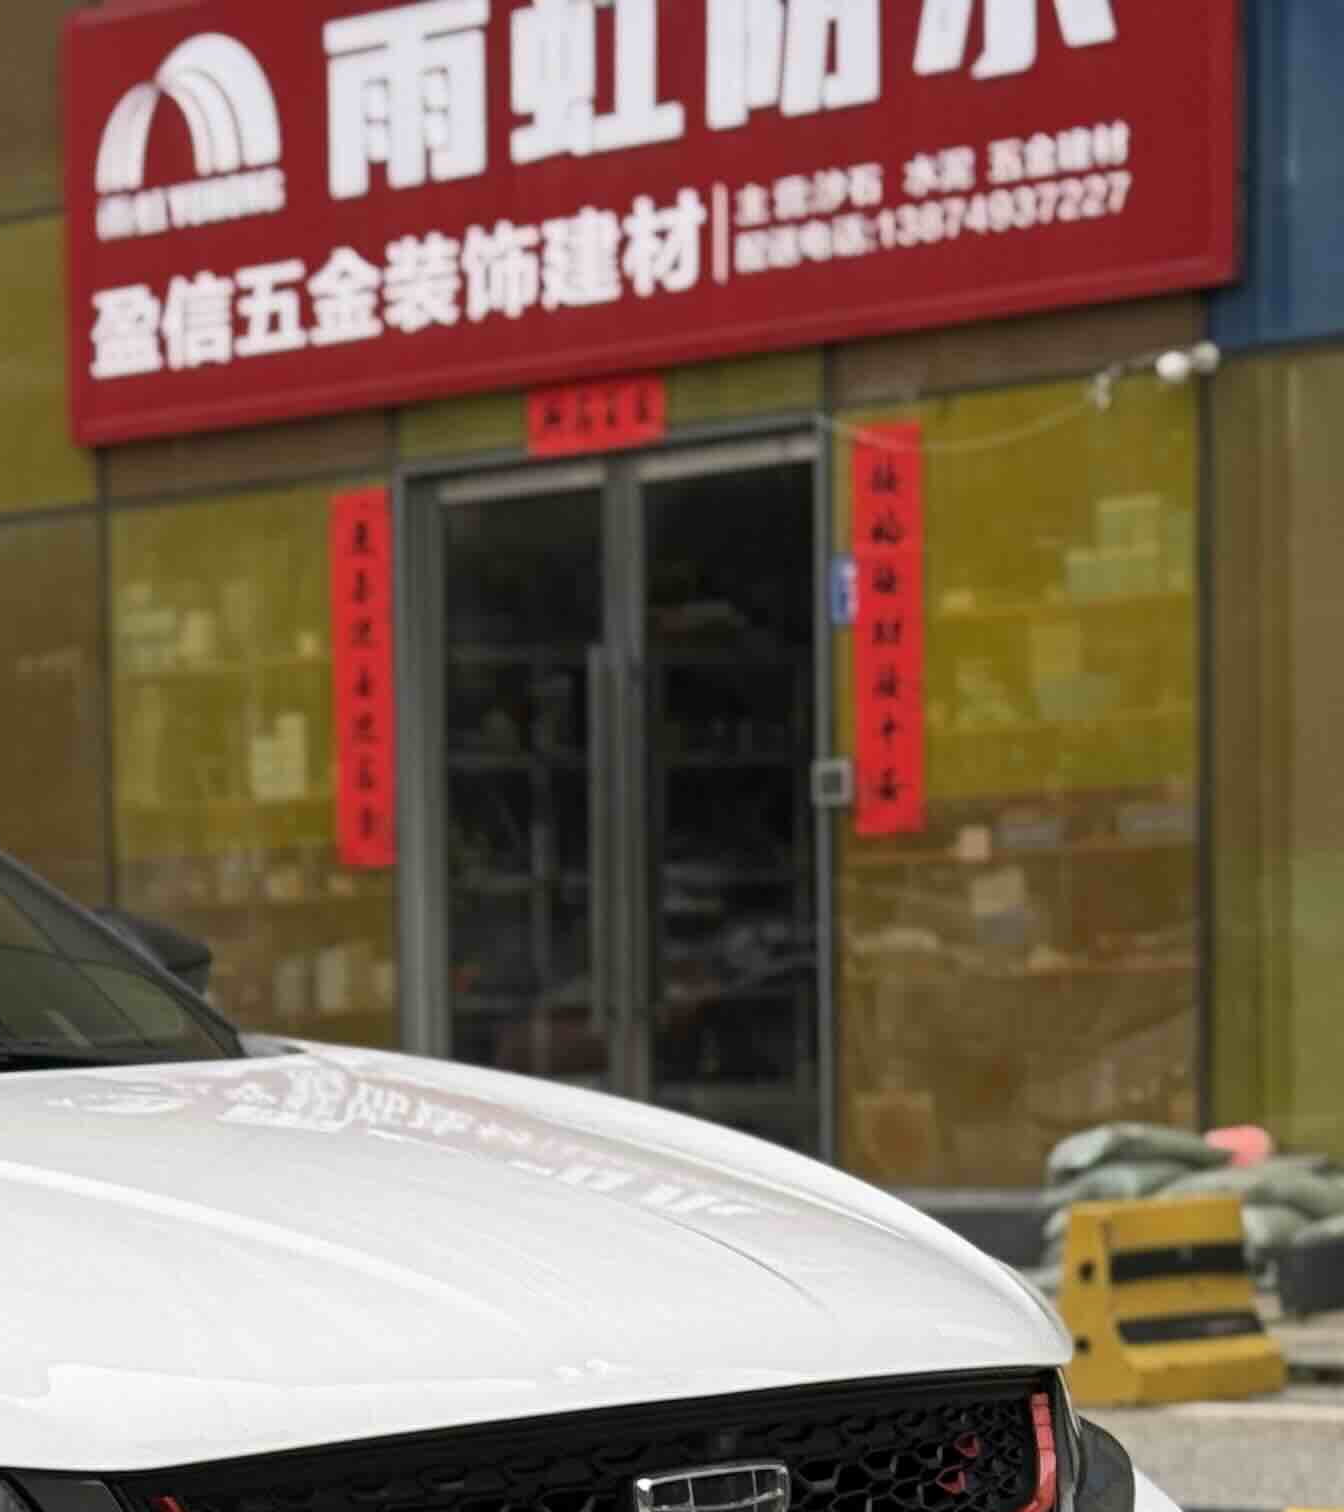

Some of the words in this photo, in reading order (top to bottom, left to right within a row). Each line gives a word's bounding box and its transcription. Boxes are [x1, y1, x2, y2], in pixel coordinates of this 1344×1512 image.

[91, 188, 706, 379] 盈信五金装饰建材
